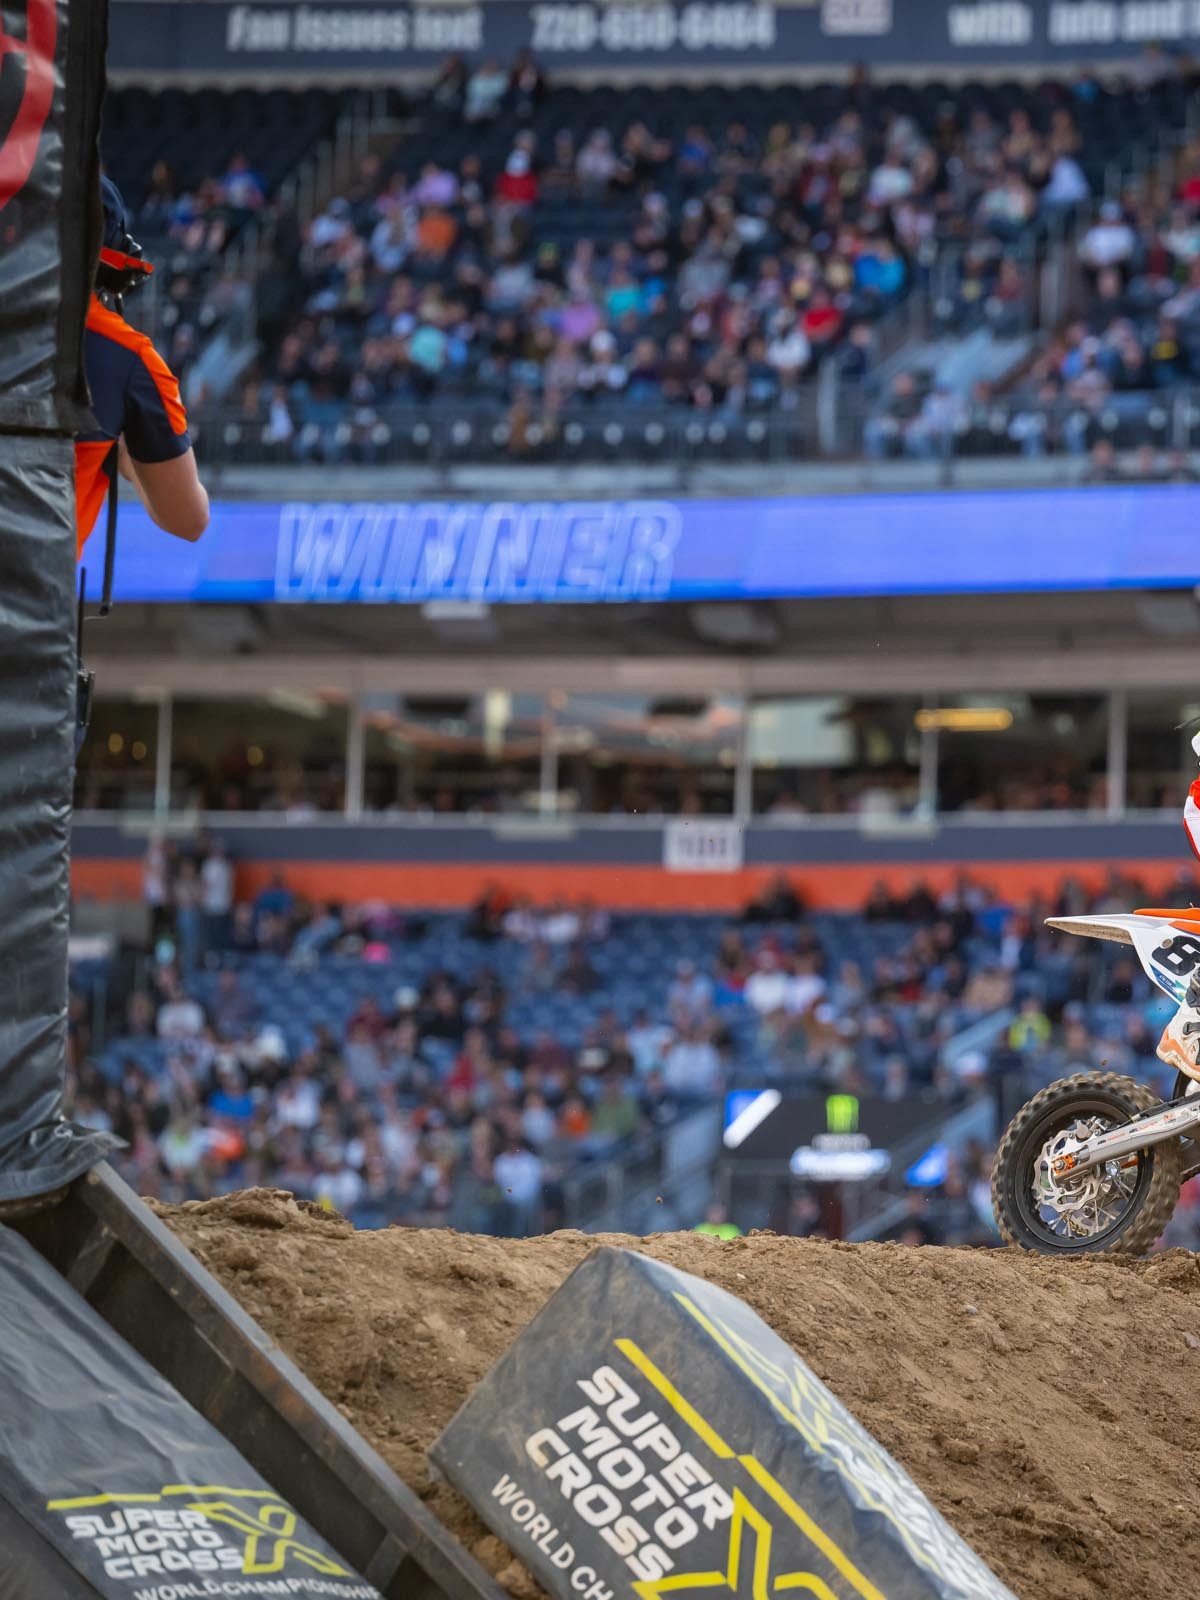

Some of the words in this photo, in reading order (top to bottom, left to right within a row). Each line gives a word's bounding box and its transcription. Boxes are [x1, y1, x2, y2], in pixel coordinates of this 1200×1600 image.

[275, 501, 684, 604] WINNER
[556, 1406, 699, 1549] MOTO
[576, 1366, 735, 1530] SUPER
[66, 1508, 212, 1538] SUPER
[94, 1528, 224, 1557] MOTO
[491, 1474, 575, 1568] WORLD
[525, 1428, 675, 1582] CROSS
[103, 1548, 245, 1579] CROSS
